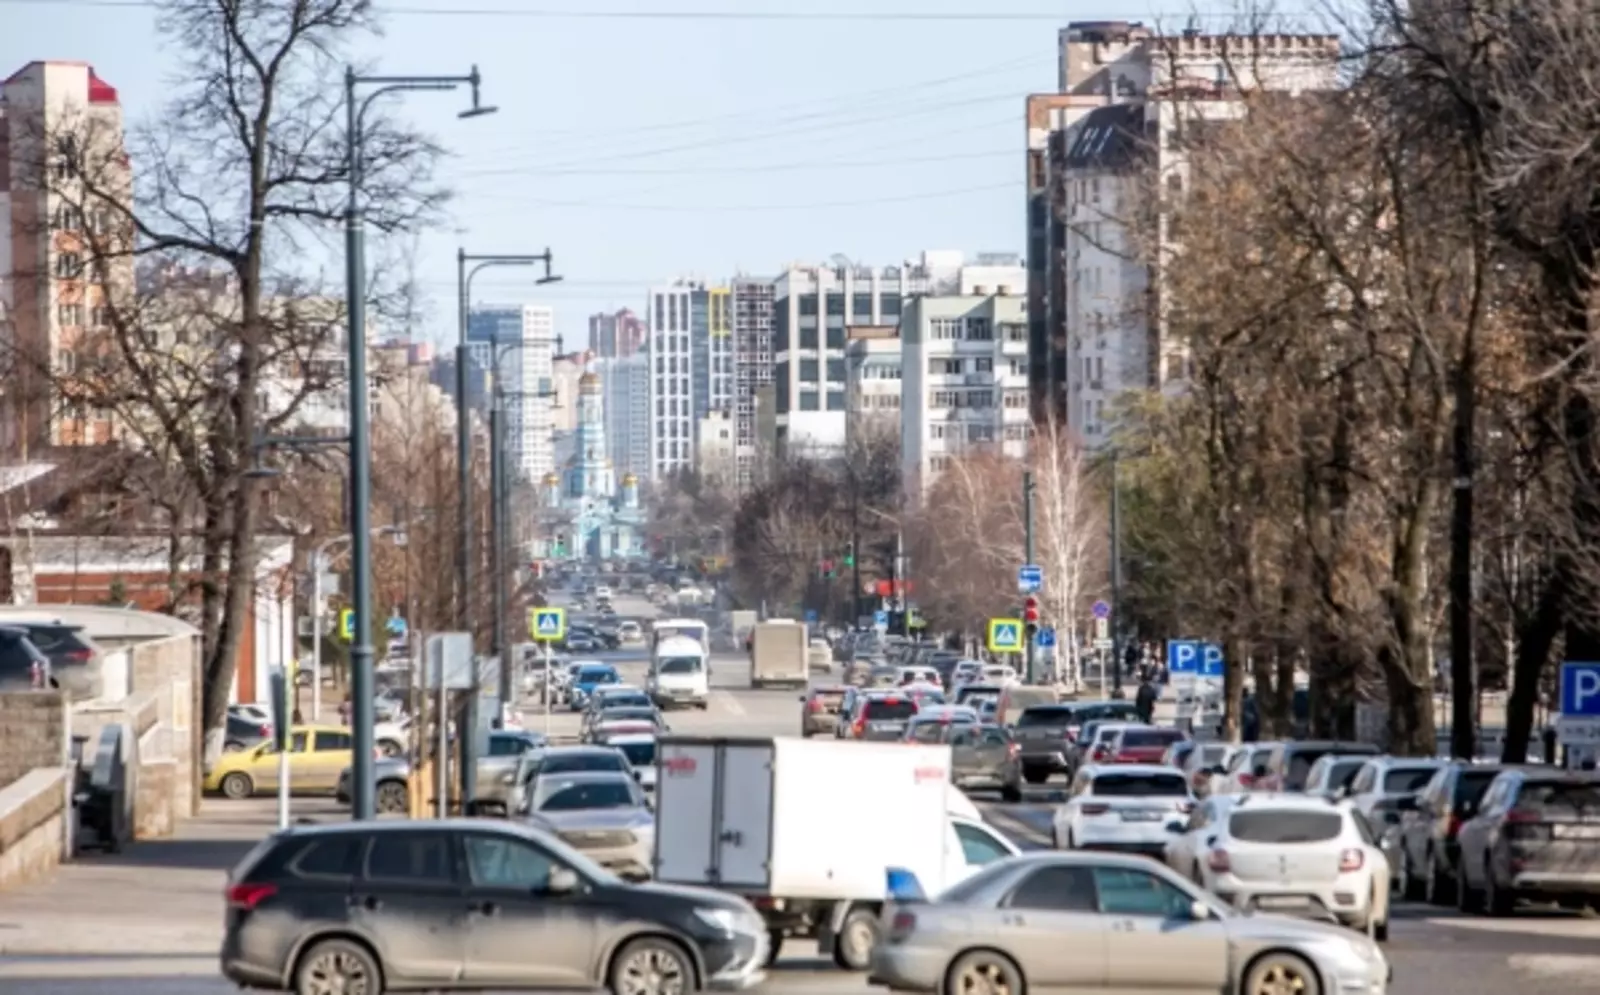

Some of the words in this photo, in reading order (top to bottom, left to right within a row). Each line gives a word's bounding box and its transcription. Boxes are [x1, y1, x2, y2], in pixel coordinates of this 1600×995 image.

[1176, 644, 1195, 668] P
[1204, 646, 1223, 673] P
[1575, 669, 1600, 711] P
